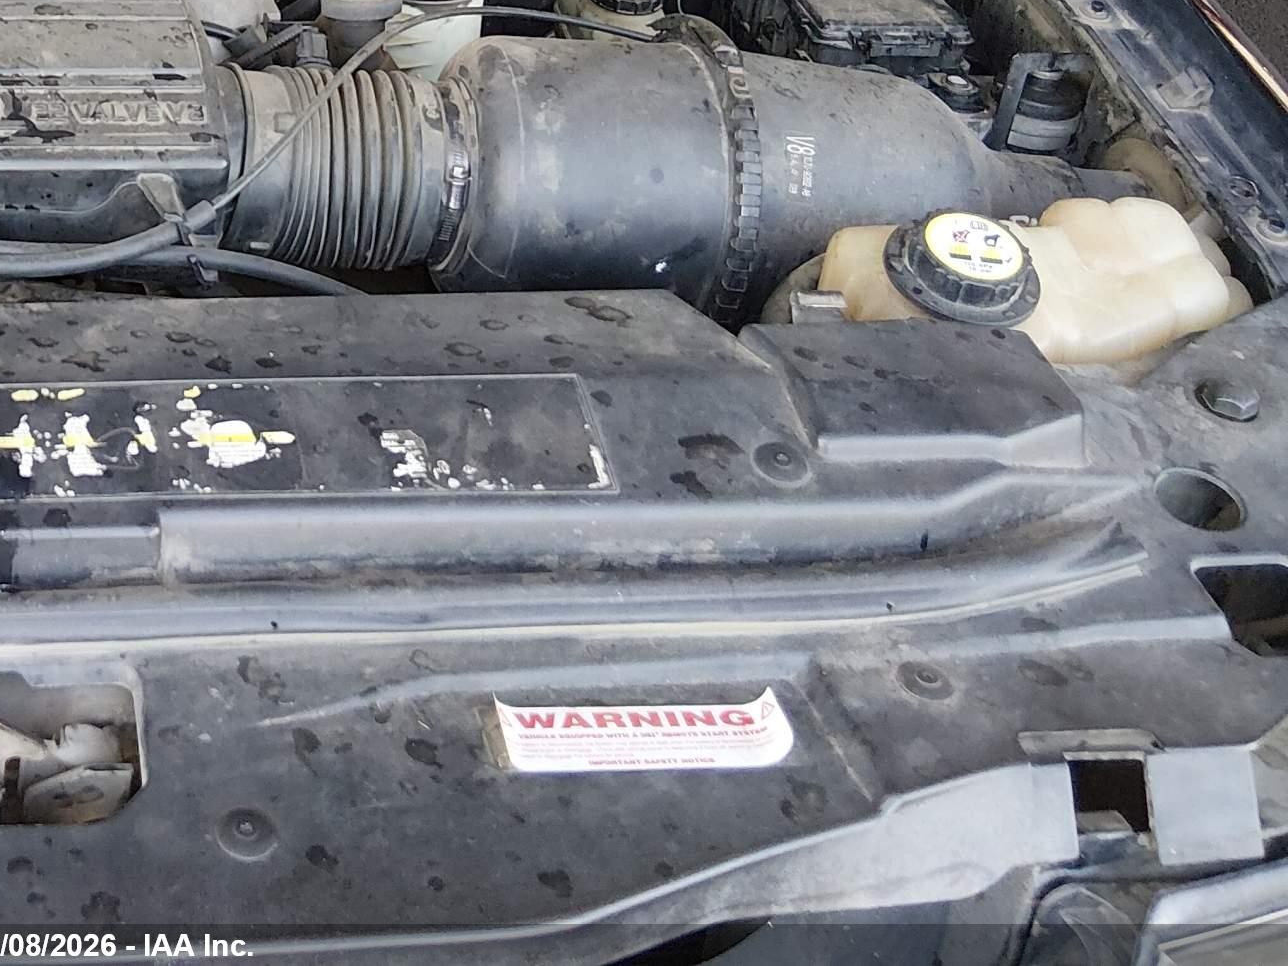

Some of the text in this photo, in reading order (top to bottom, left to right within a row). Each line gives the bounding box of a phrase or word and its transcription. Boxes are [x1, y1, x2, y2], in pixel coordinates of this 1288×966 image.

[71, 100, 162, 124] VALVE
[786, 135, 816, 156] V8
[513, 709, 755, 729] WARNING
